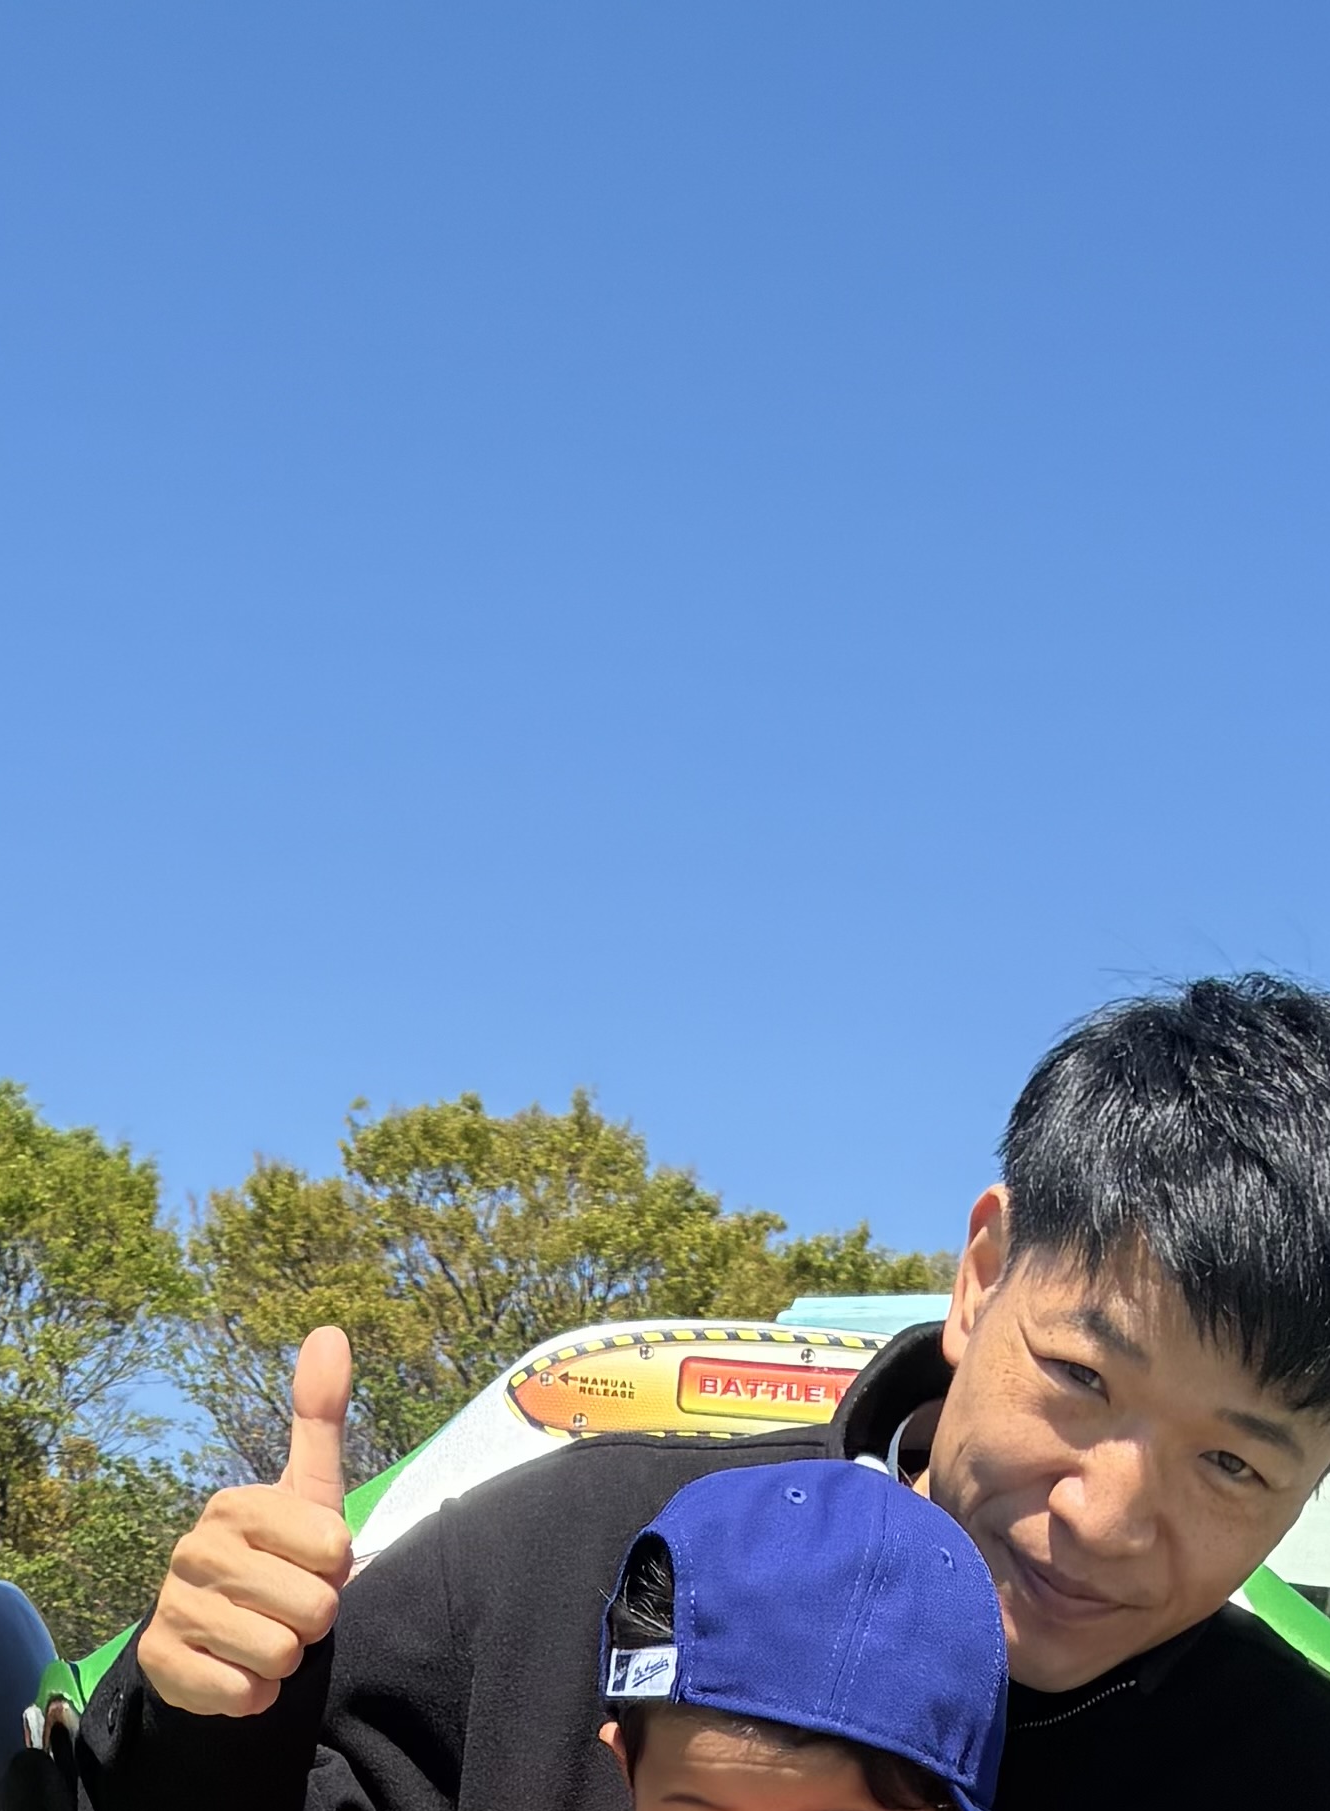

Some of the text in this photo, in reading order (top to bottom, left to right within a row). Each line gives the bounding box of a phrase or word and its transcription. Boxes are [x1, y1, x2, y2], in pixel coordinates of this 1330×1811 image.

[579, 1376, 636, 1389] MANUAL
[700, 1375, 825, 1402] BATTLE
[579, 1386, 635, 1399] RELEASE
